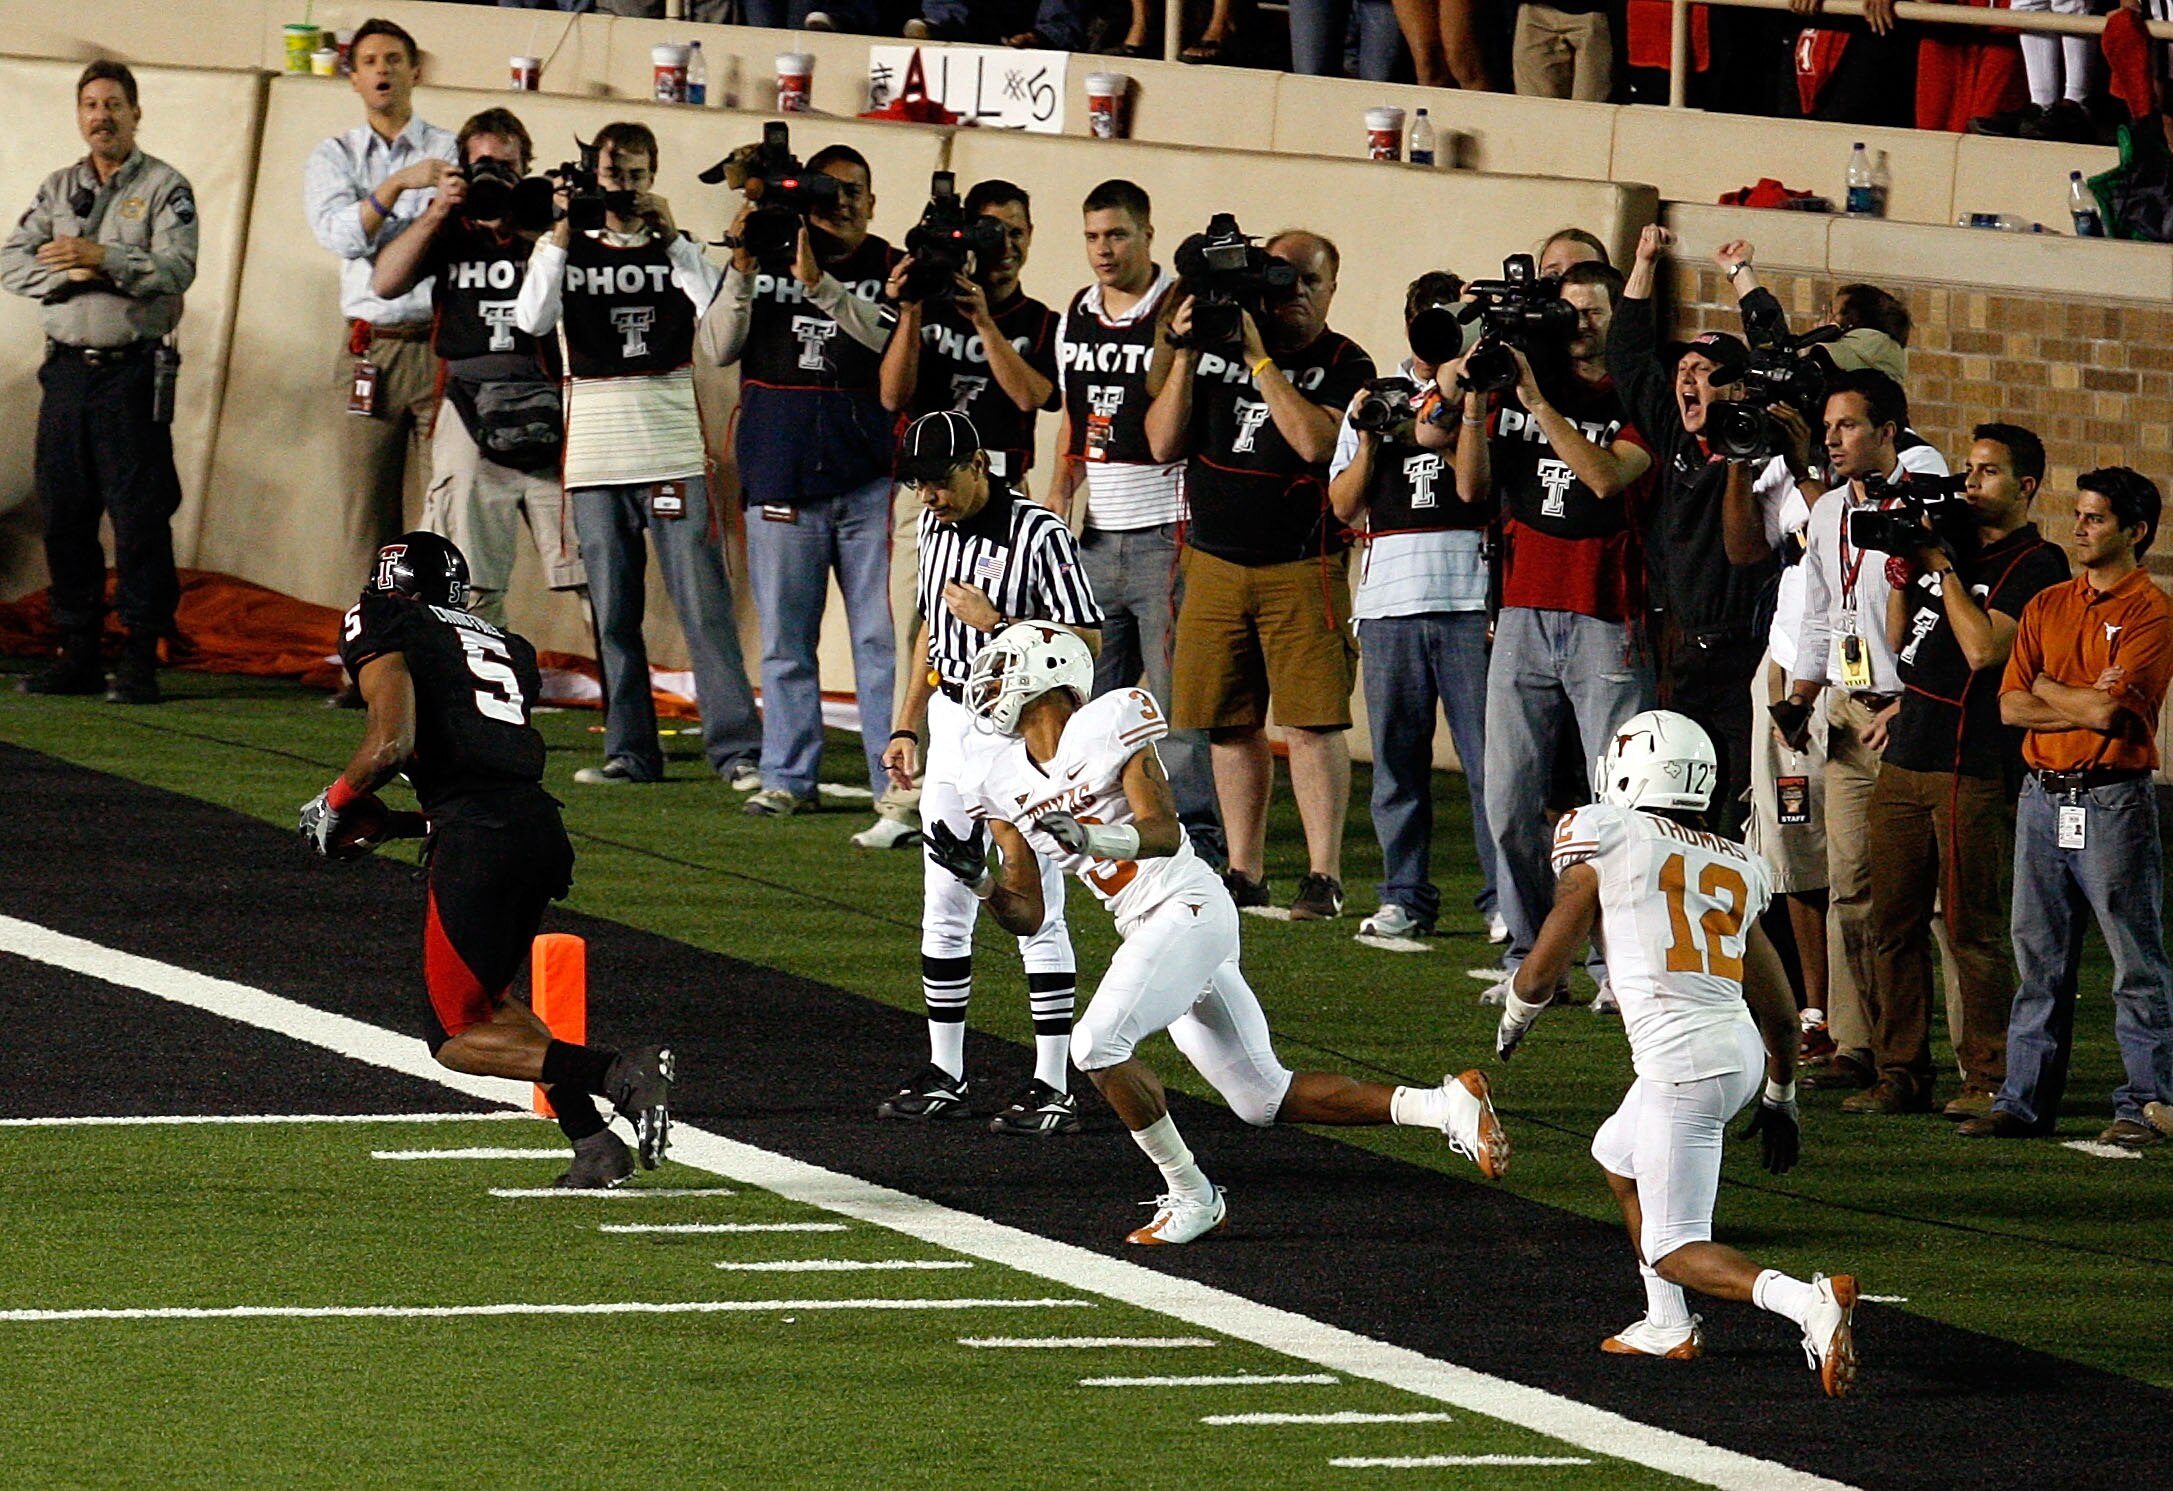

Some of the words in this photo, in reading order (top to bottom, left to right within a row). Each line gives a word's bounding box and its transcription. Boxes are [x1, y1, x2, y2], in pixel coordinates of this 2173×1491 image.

[1003, 66, 1056, 121] #5
[753, 274, 881, 304] PHO
[1196, 352, 1325, 391] PHO
[344, 603, 362, 642] 5
[455, 626, 525, 726] 5
[1129, 690, 1159, 720] 3
[1685, 762, 1709, 795] 12
[1649, 814, 1749, 862] THOMAS
[1781, 814, 1806, 823] STAFF
[1658, 852, 1748, 983] 12
